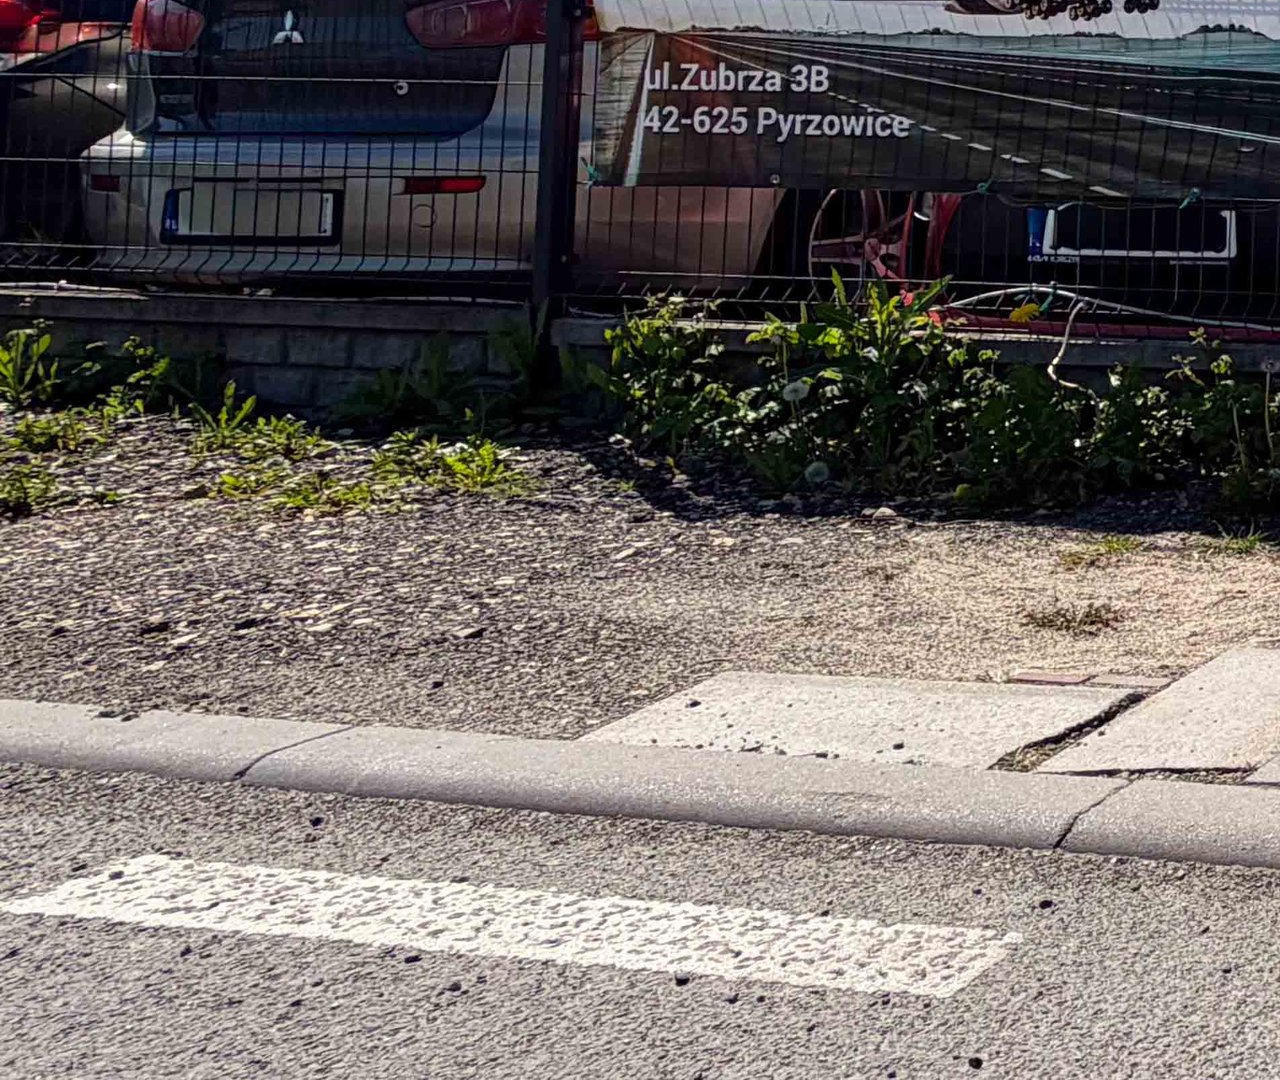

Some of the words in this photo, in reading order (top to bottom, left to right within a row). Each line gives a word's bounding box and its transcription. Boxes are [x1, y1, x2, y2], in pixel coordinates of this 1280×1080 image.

[790, 65, 829, 93] 3B
[644, 105, 748, 135] 42-625
[756, 107, 911, 143] Pyrzowice
